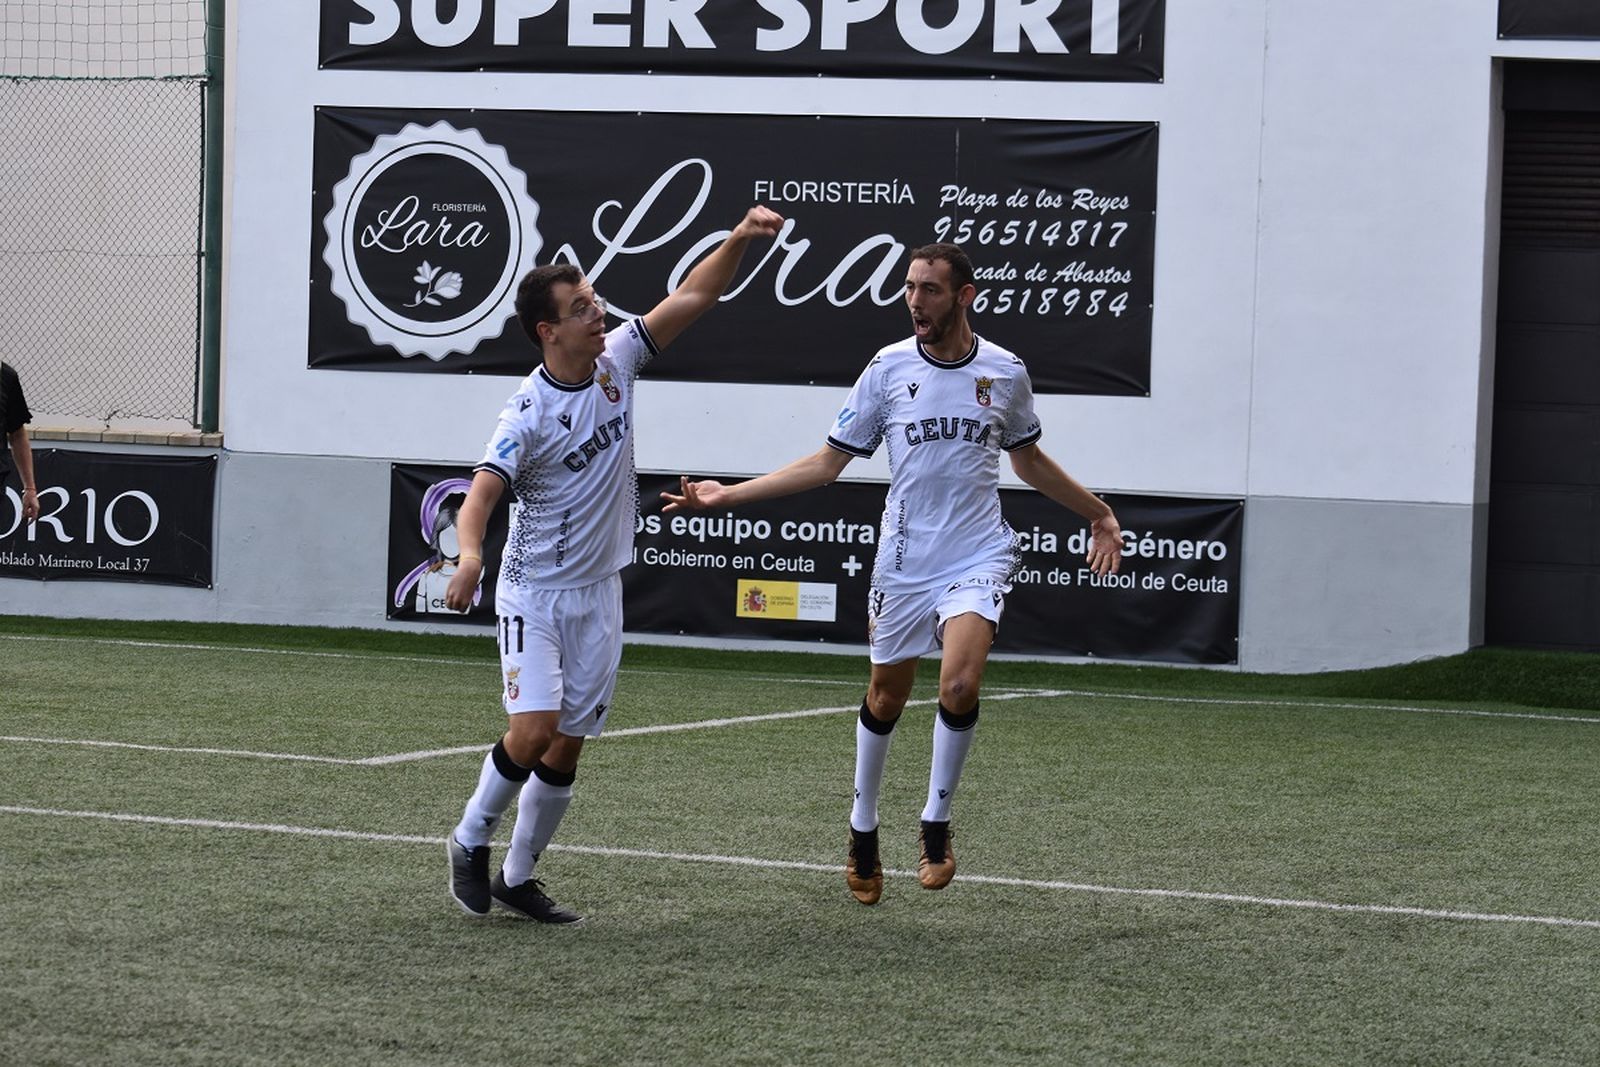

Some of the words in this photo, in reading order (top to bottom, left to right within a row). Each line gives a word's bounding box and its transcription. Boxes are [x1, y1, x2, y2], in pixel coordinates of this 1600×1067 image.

[348, 0, 717, 49] SUPER
[755, 0, 1120, 55] SPORT
[432, 203, 487, 212] FLORISTERÍA
[754, 179, 915, 205] FLORISTERÍA
[939, 184, 998, 214] Plaza
[1005, 188, 1028, 208] de
[1035, 188, 1062, 209] los
[1071, 188, 1129, 216] Reyes
[361, 195, 490, 253] Lara
[934, 216, 1128, 248] 956514817
[972, 261, 1017, 281] cado
[1024, 262, 1048, 282] de
[1051, 260, 1132, 284] Abastos
[904, 416, 992, 448] CEUTA
[670, 512, 772, 545] equipo
[780, 518, 875, 544] contra
[1067, 528, 1094, 554] d
[1119, 531, 1227, 561] Género
[0, 551, 35, 566] blado
[39, 554, 94, 569] Marinero
[98, 556, 130, 571] Local
[133, 558, 150, 572] 37
[643, 547, 727, 569] Gobierno
[732, 555, 755, 570] en
[760, 553, 815, 573] Ceuta
[1047, 567, 1071, 586] de
[1141, 571, 1166, 591] de
[1171, 573, 1228, 594] Ceuta
